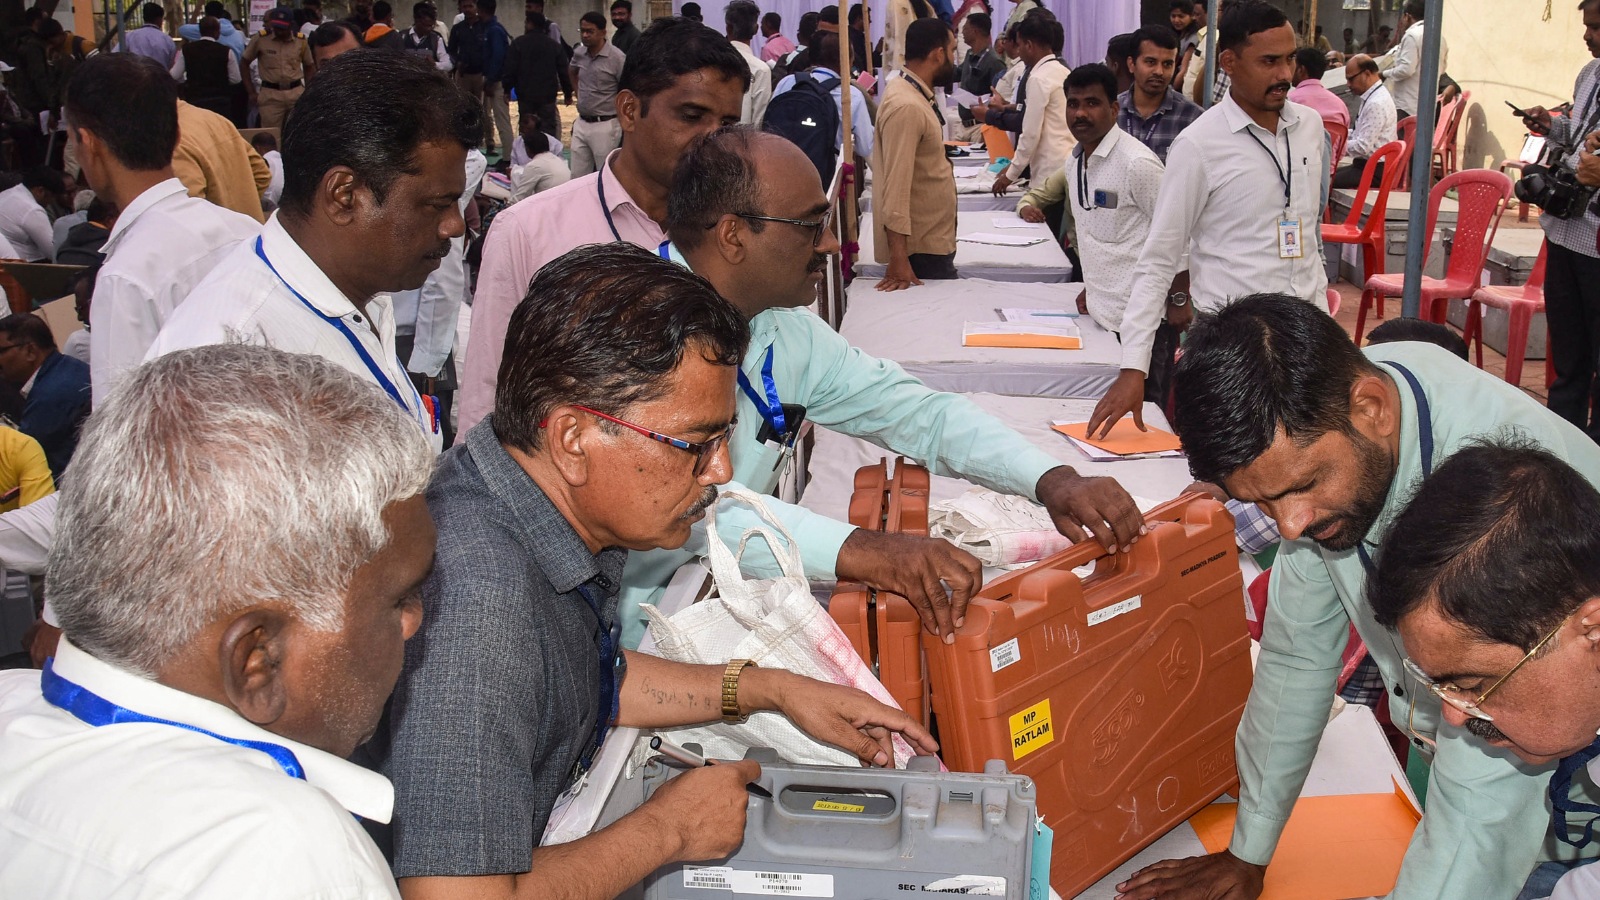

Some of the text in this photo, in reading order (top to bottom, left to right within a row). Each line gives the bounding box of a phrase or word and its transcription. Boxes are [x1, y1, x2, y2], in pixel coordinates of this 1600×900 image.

[1207, 550, 1227, 564] PRADESH
[1023, 711, 1037, 725] MP
[1014, 722, 1050, 748] RATLAM
[897, 883, 916, 891] SEC
